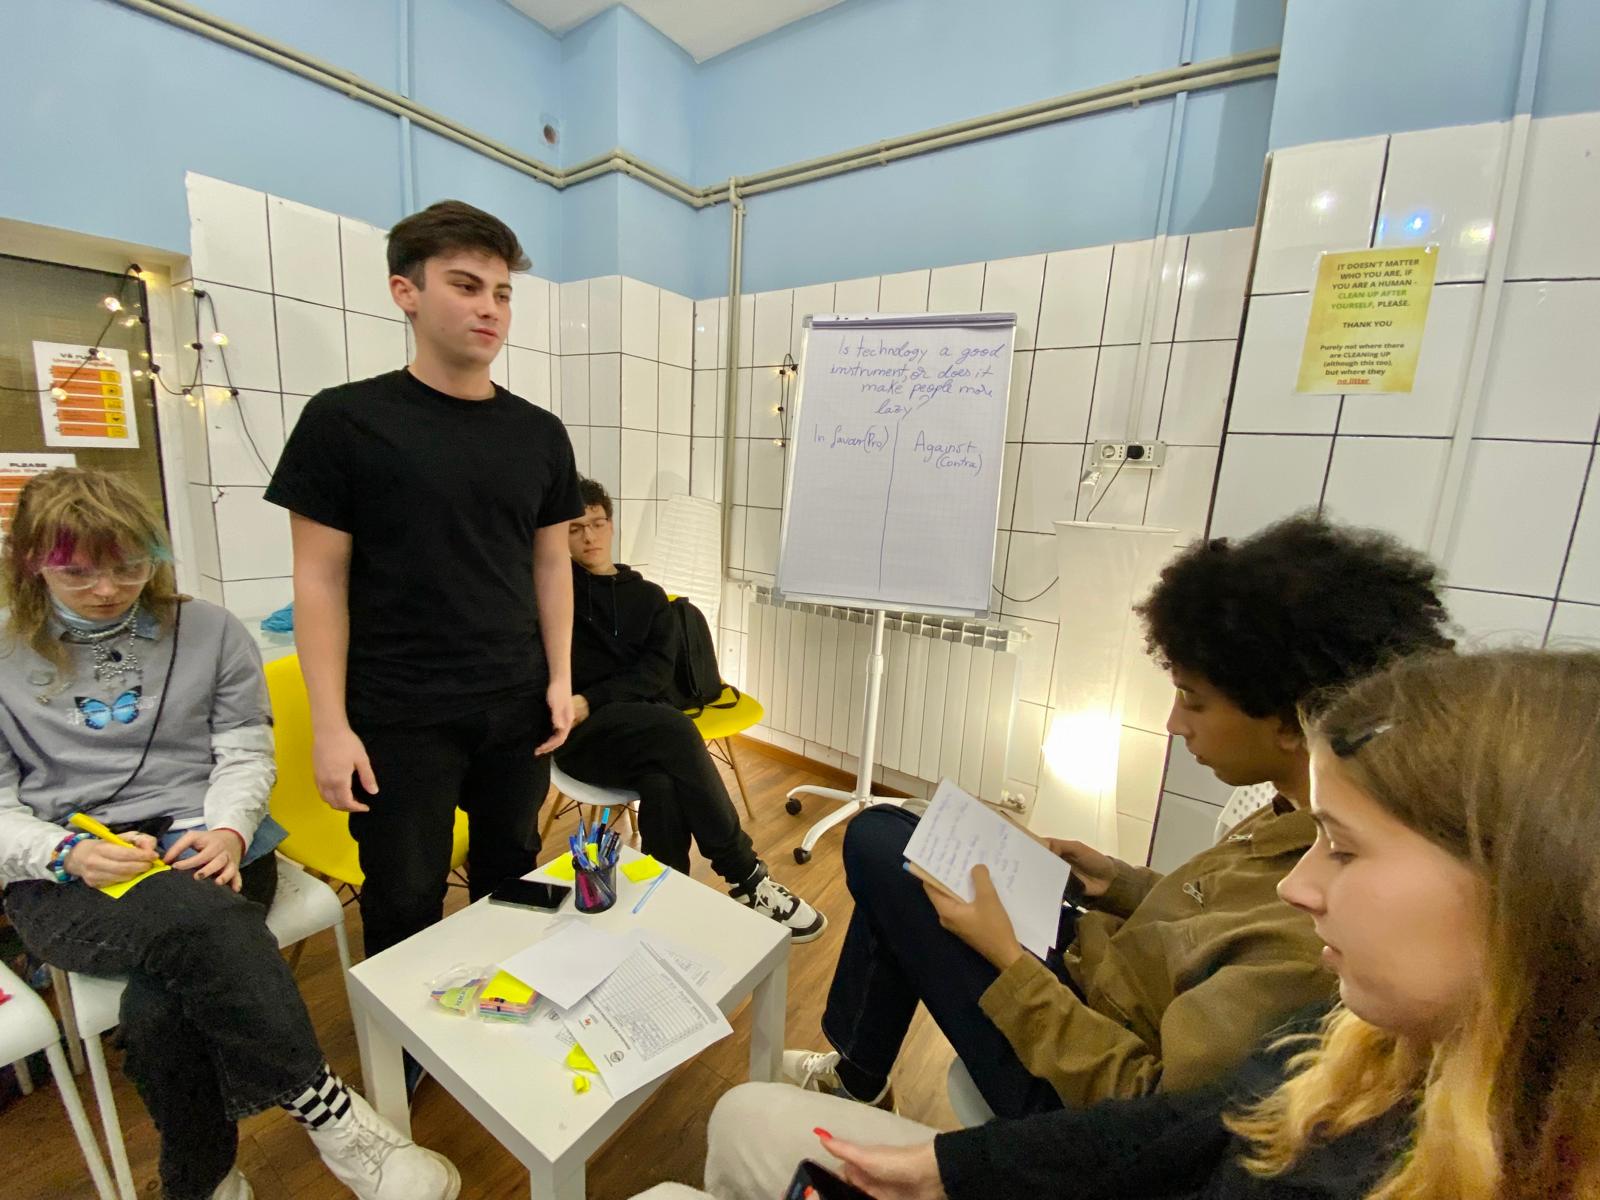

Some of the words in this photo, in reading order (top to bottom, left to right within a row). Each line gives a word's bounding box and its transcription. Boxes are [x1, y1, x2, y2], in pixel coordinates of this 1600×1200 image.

[1347, 261, 1384, 270] DOESN'T
[1385, 258, 1420, 267] MATTER
[1340, 272, 1361, 280] WHO
[1351, 281, 1368, 289] ARE
[1378, 279, 1412, 287] HUMAN
[1338, 291, 1365, 300] CLEAN
[1367, 290, 1379, 298] UP
[1380, 289, 1407, 297] AFTER
[1331, 301, 1375, 310] YOURSELF,
[839, 335, 849, 355] Is
[856, 335, 928, 364] technology
[939, 346, 952, 357] a
[955, 343, 1006, 364] good
[937, 364, 971, 379] does
[975, 364, 993, 378] it
[1368, 368, 1386, 376] they
[861, 380, 904, 395] make
[908, 379, 953, 400] people
[959, 384, 993, 398] more
[814, 424, 825, 442] In
[914, 430, 978, 463] Against
